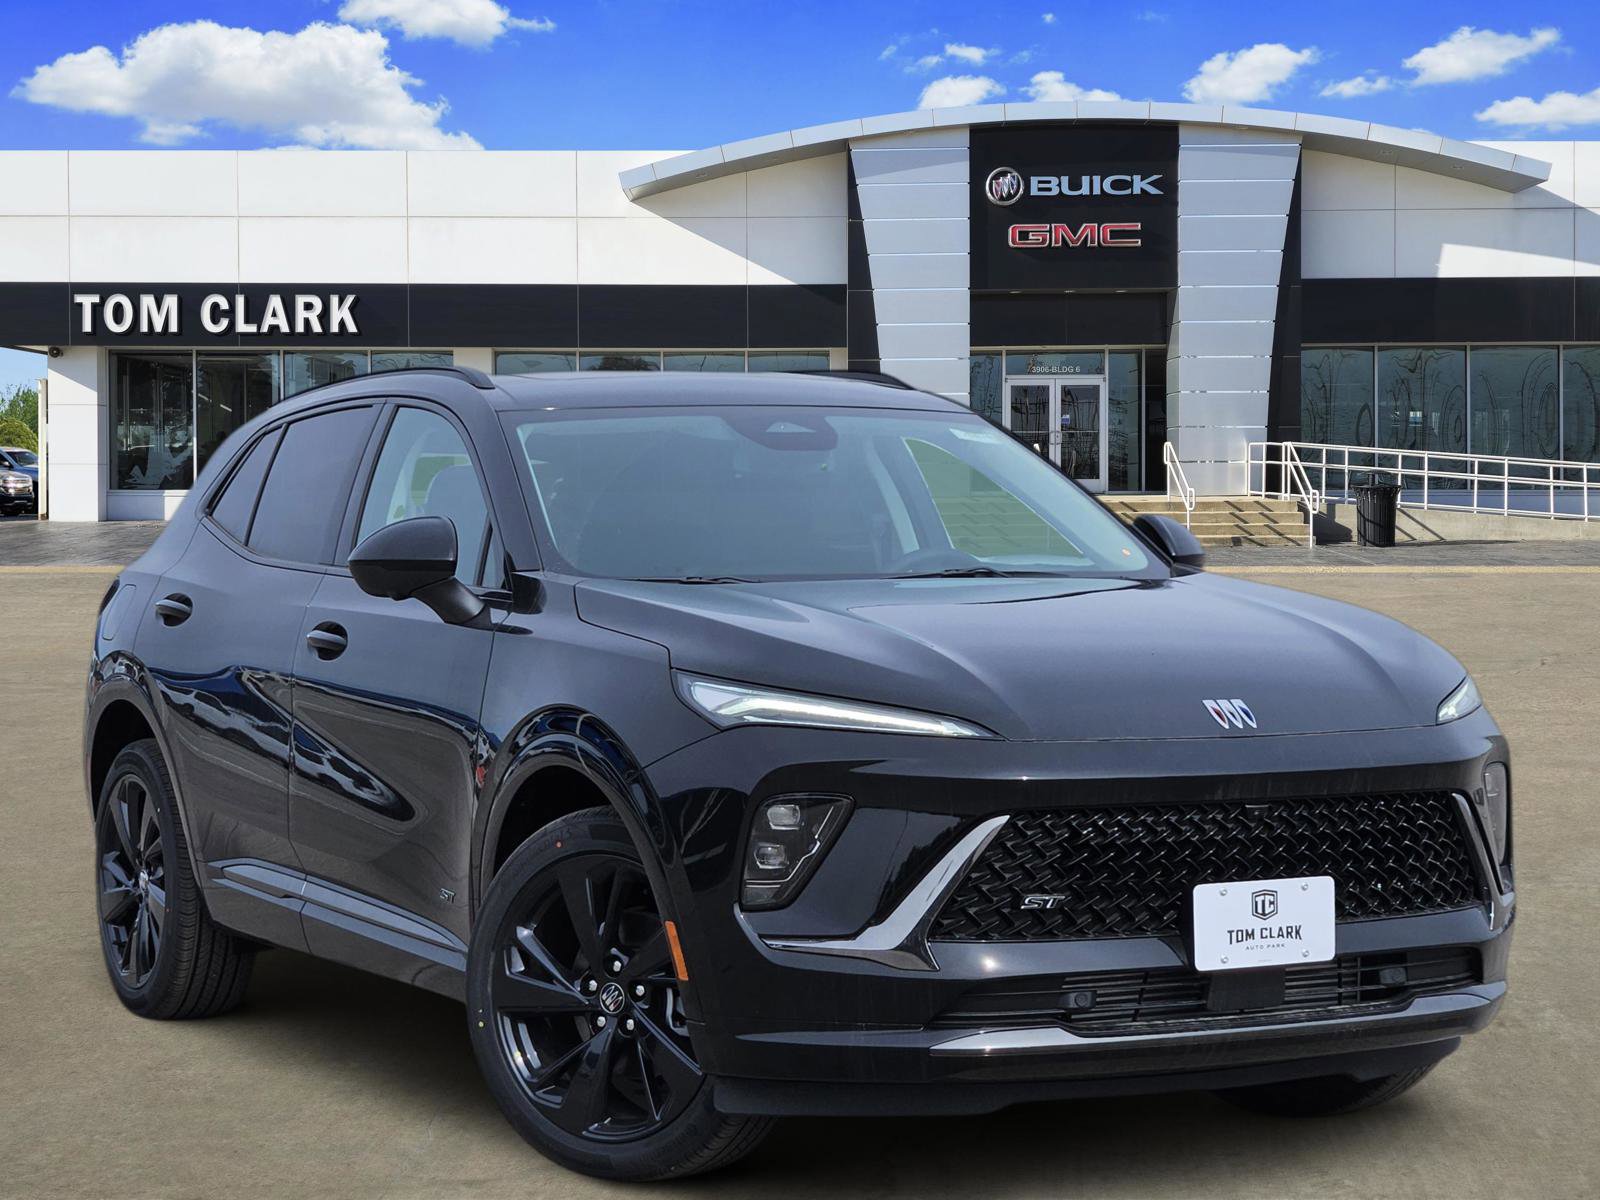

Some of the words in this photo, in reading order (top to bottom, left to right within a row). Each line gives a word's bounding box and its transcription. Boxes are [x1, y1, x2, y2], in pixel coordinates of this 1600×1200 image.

[1030, 174, 1165, 196] BUICK
[1008, 223, 1142, 248] GMC
[73, 293, 179, 334] TOM
[200, 293, 360, 334] CLARK
[1021, 894, 1066, 909] ST
[1227, 928, 1256, 945] TOM
[1260, 924, 1303, 940] CLARK
